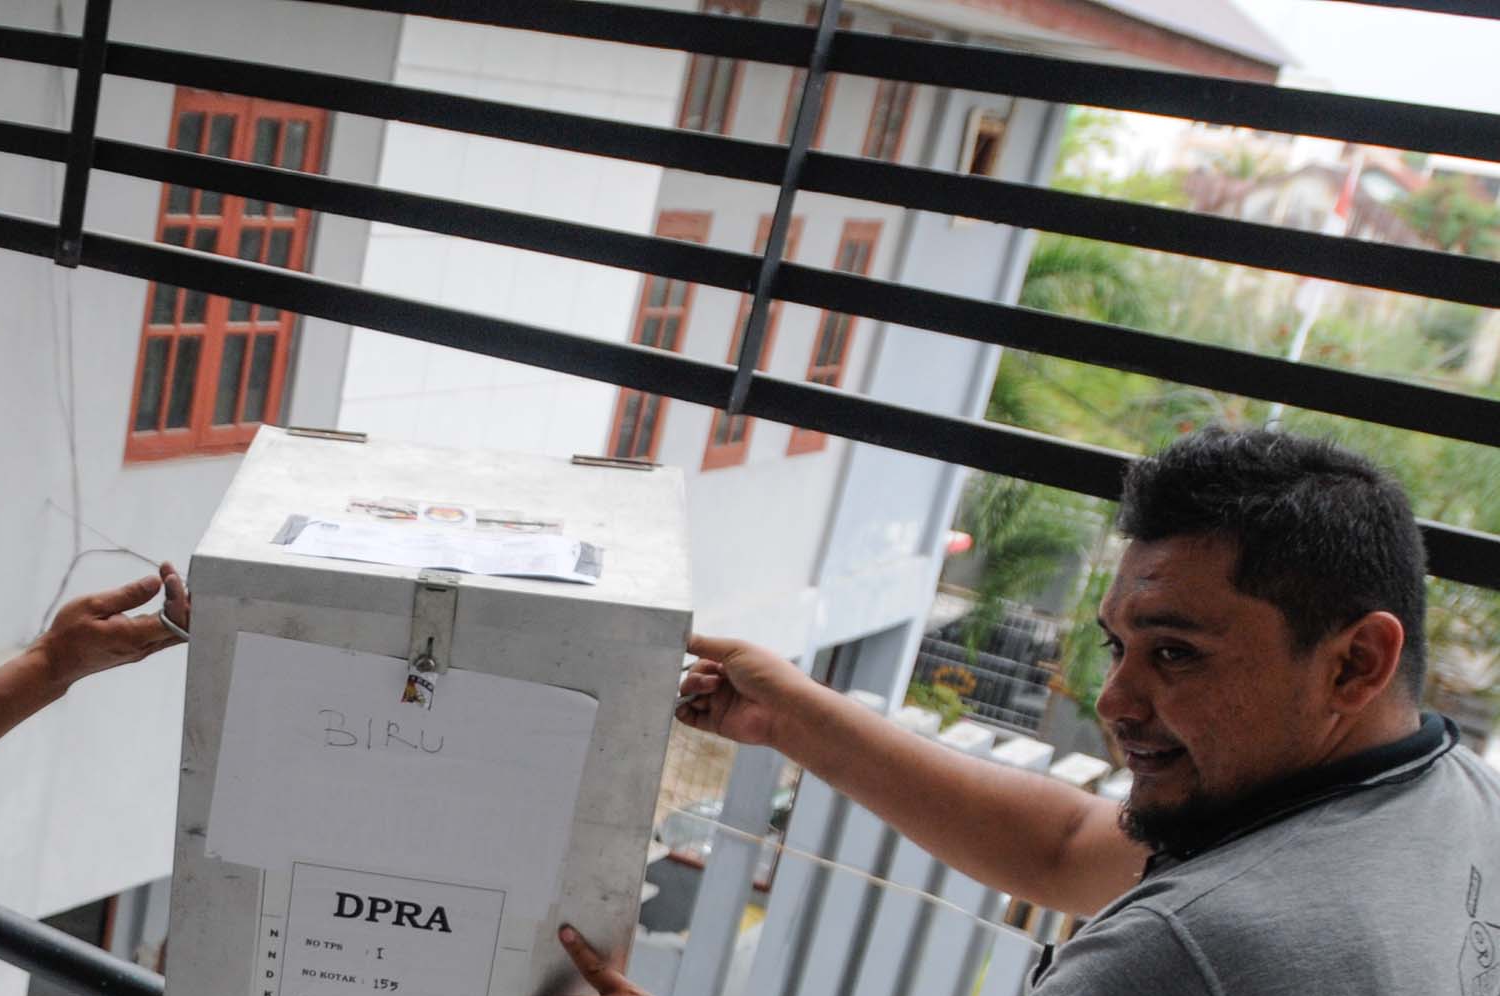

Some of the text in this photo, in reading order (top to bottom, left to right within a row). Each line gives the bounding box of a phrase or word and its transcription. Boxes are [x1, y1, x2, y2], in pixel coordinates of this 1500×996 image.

[318, 709, 444, 754] BIRU
[333, 892, 452, 932] DPRA
[305, 938, 321, 948] NO
[302, 968, 398, 992] NO KOTAK 155
